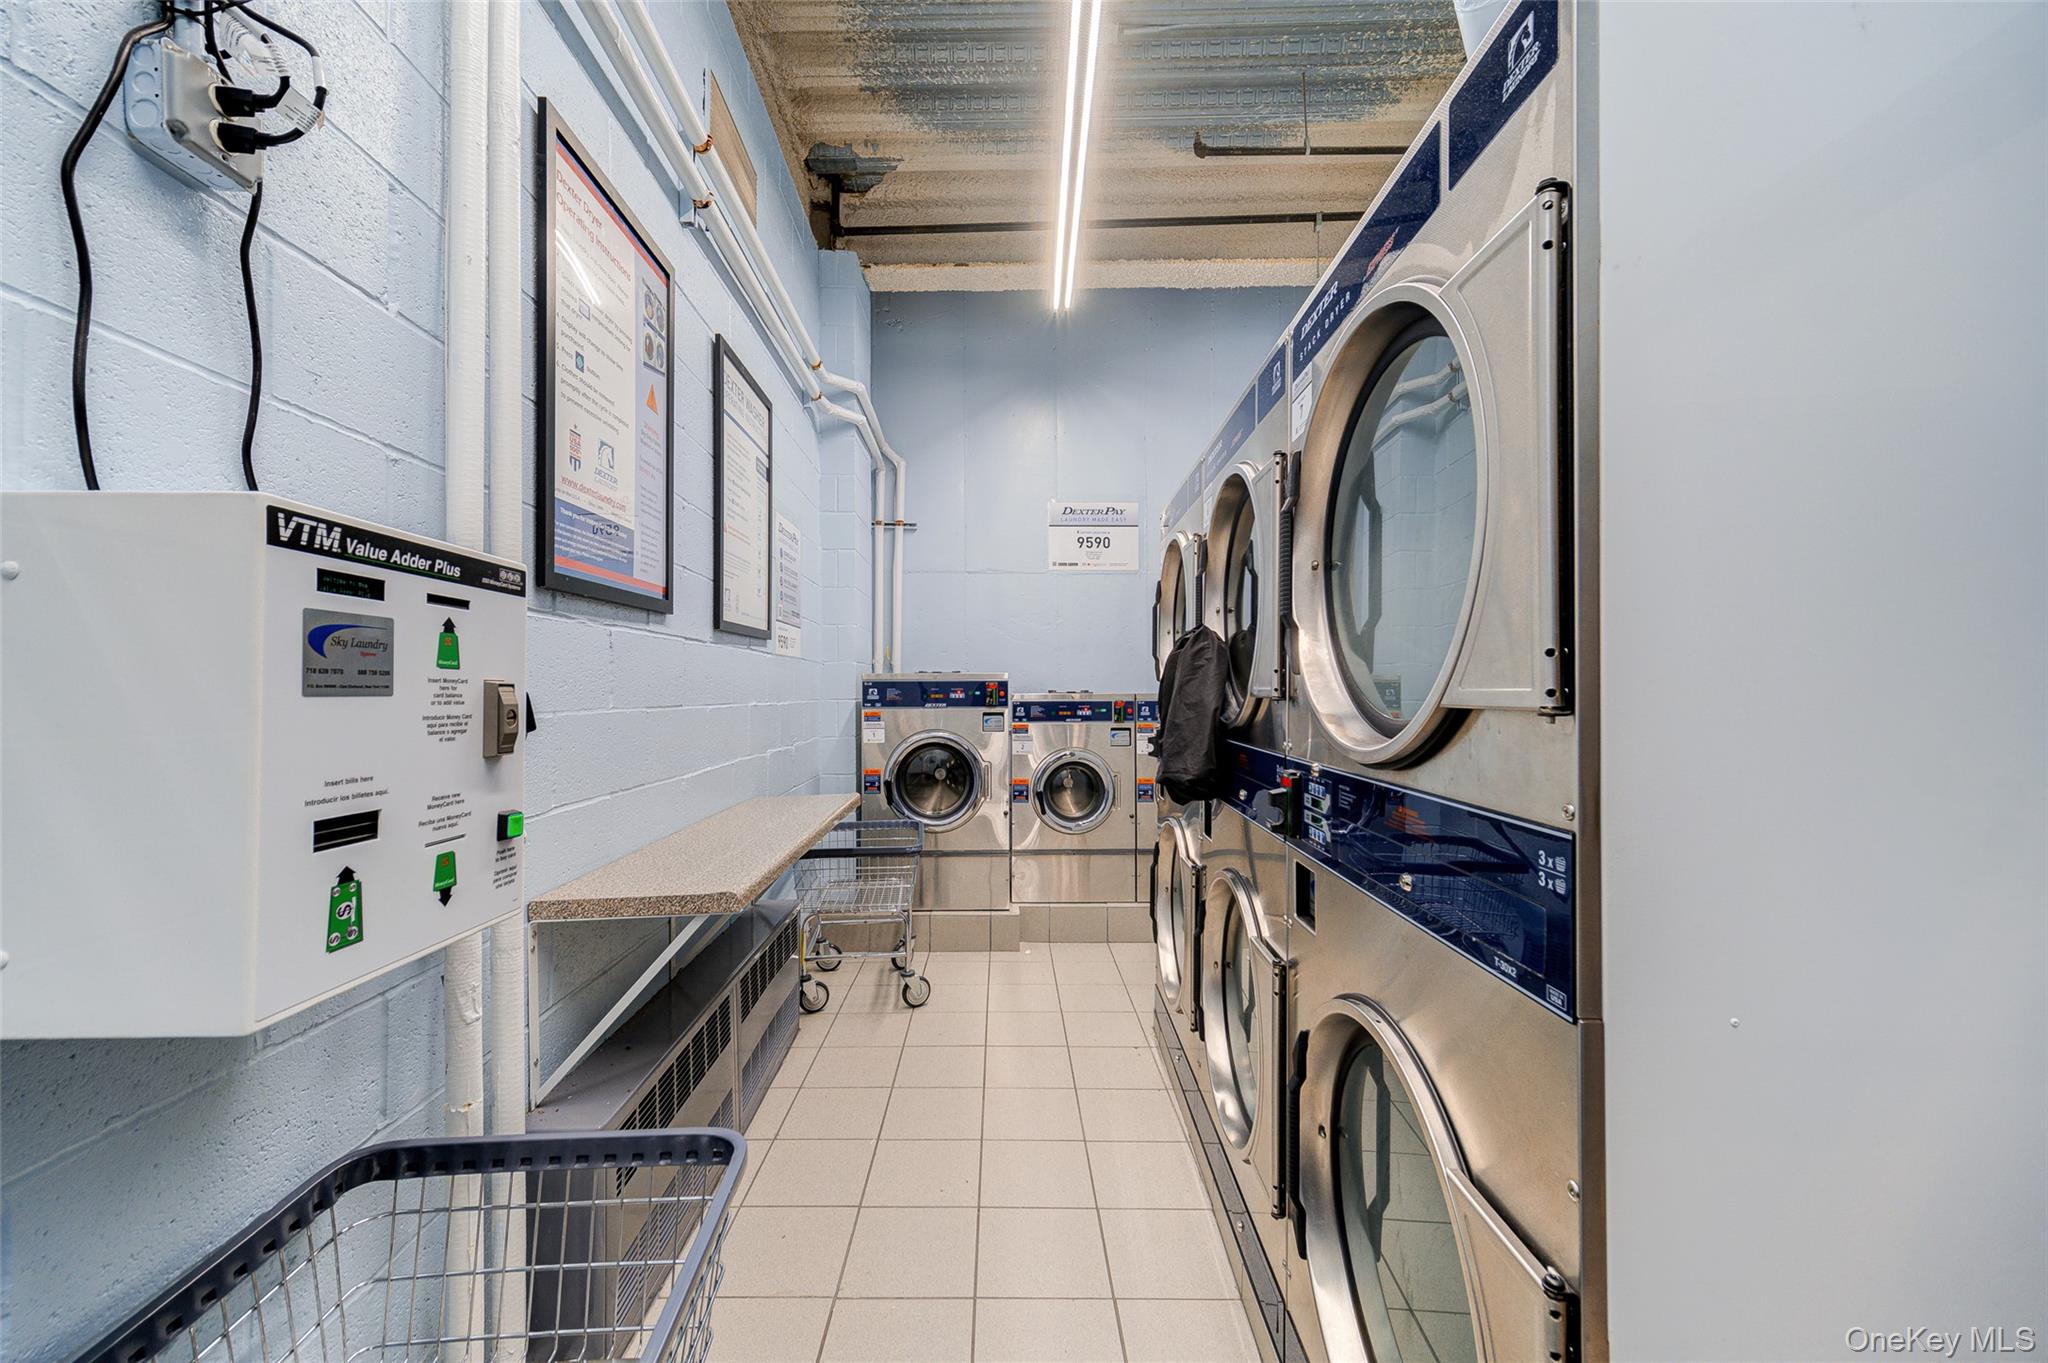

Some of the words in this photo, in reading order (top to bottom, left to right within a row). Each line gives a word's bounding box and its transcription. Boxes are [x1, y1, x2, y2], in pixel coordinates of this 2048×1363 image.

[1502, 41, 1541, 93] DEXTER
[557, 168, 582, 206] Dexter
[583, 200, 603, 230] Dryer
[557, 191, 595, 243] Operating
[595, 235, 632, 282] Instructions
[1300, 280, 1339, 341] DEXTER
[1299, 329, 1322, 362] STACK
[1324, 291, 1351, 330] DRYER
[594, 467, 618, 486] DEXTER
[277, 511, 342, 553] VTM
[346, 537, 388, 561] Value
[390, 549, 432, 571] Adder
[434, 559, 462, 577] Plus
[1077, 536, 1111, 549] 9590
[330, 636, 348, 650] Sky
[350, 637, 389, 652] Laundry
[443, 677, 468, 685] MoneyCard
[324, 779, 343, 787] Insert
[345, 777, 358, 785] bills
[304, 796, 339, 807] Introducir
[351, 791, 374, 800] billetes
[427, 800, 454, 810] MoneyCard
[431, 794, 451, 802] Receive
[446, 811, 472, 821] MoneyCard
[496, 848, 506, 856] Push
[1538, 850, 1546, 866] 3
[1547, 857, 1554, 869] x
[1538, 871, 1546, 887] 3
[1547, 879, 1554, 890] x
[1493, 956, 1518, 979] T-30X2
[1549, 994, 1563, 1006] USA
